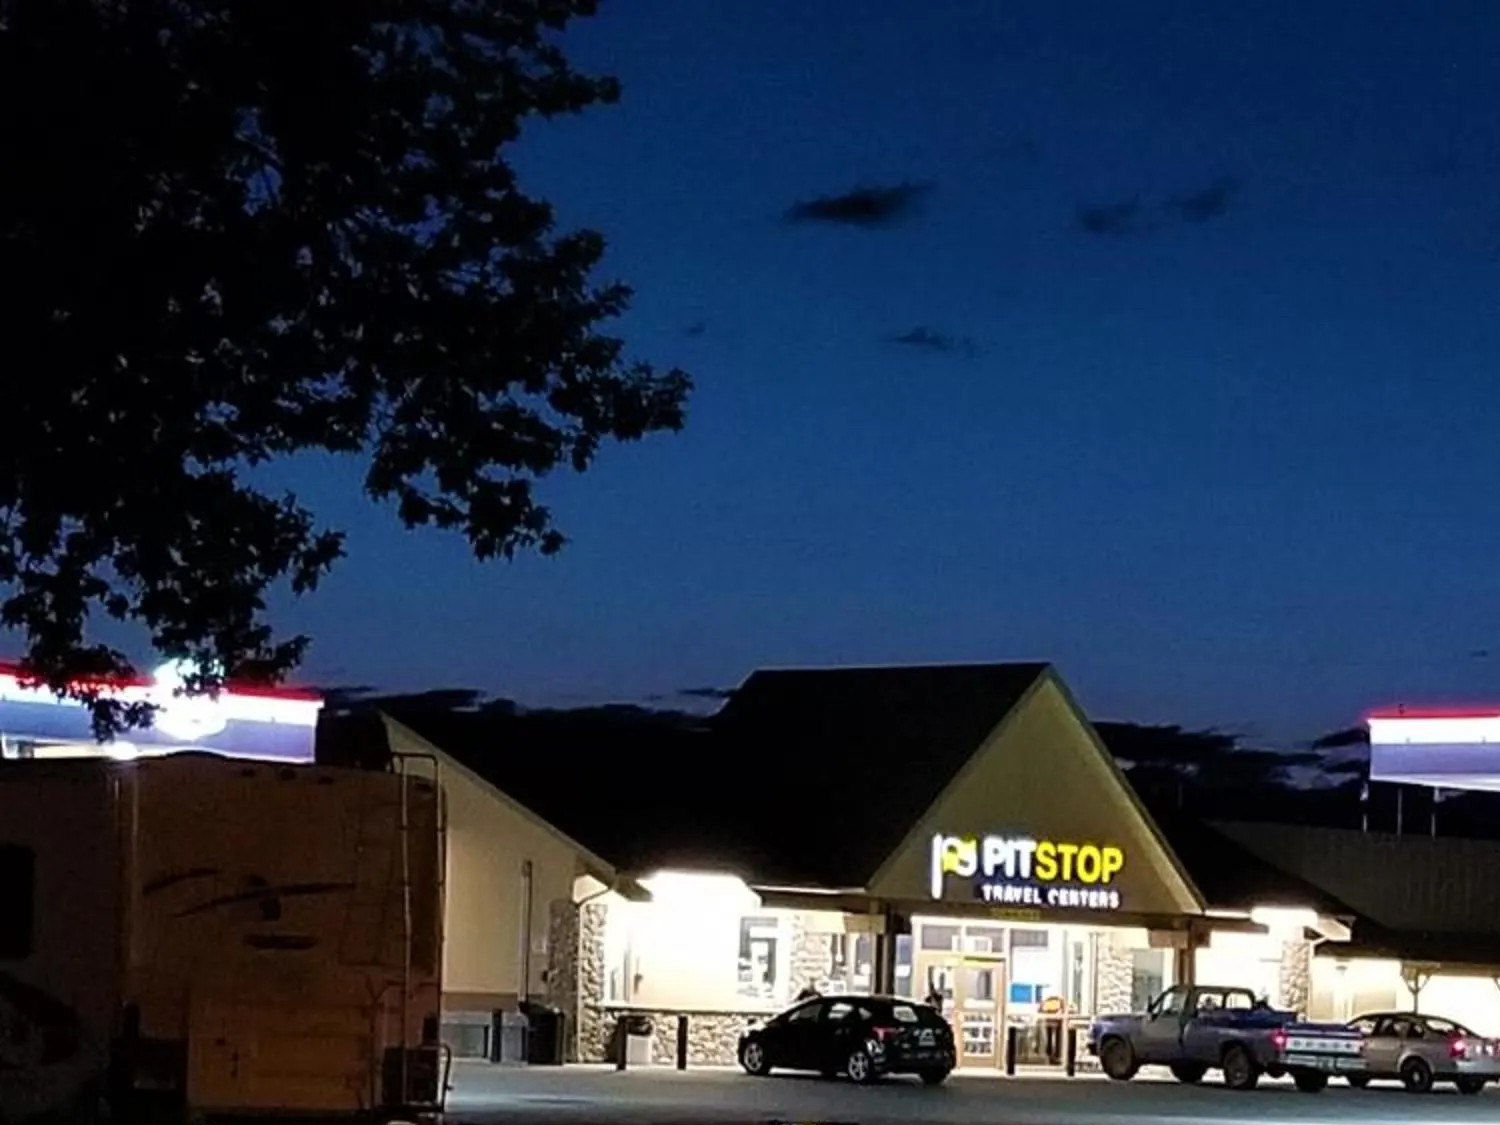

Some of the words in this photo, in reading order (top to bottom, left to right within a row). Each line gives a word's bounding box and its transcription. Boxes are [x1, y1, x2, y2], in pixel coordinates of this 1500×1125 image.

[983, 836, 1123, 883] PITSTOP
[982, 884, 1042, 904] TRAVEL
[1047, 887, 1119, 909] CENTERS
